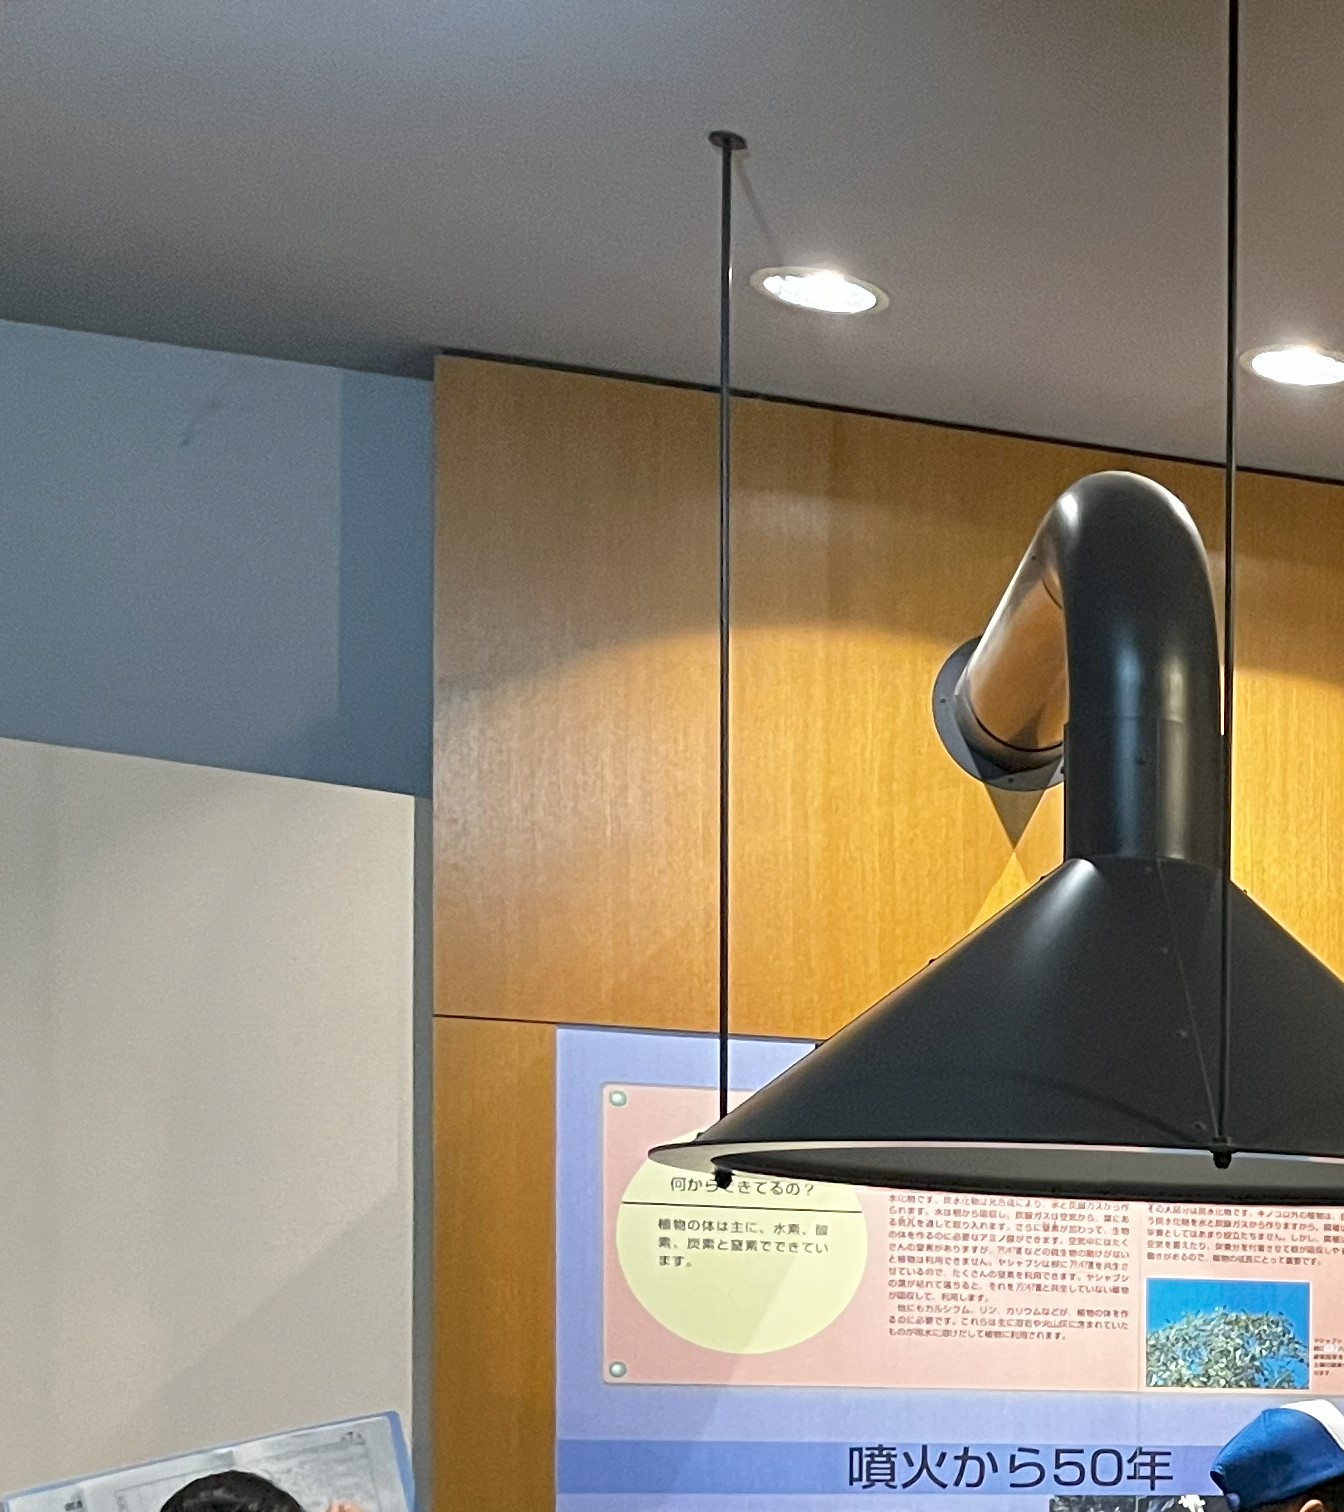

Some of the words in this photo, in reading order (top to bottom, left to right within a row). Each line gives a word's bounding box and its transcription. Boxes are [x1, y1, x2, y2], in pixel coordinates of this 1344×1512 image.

[670, 1176, 815, 1197] 何からきてるの？
[658, 1255, 692, 1267] ます。
[847, 1444, 1174, 1491] 噴火から50年
